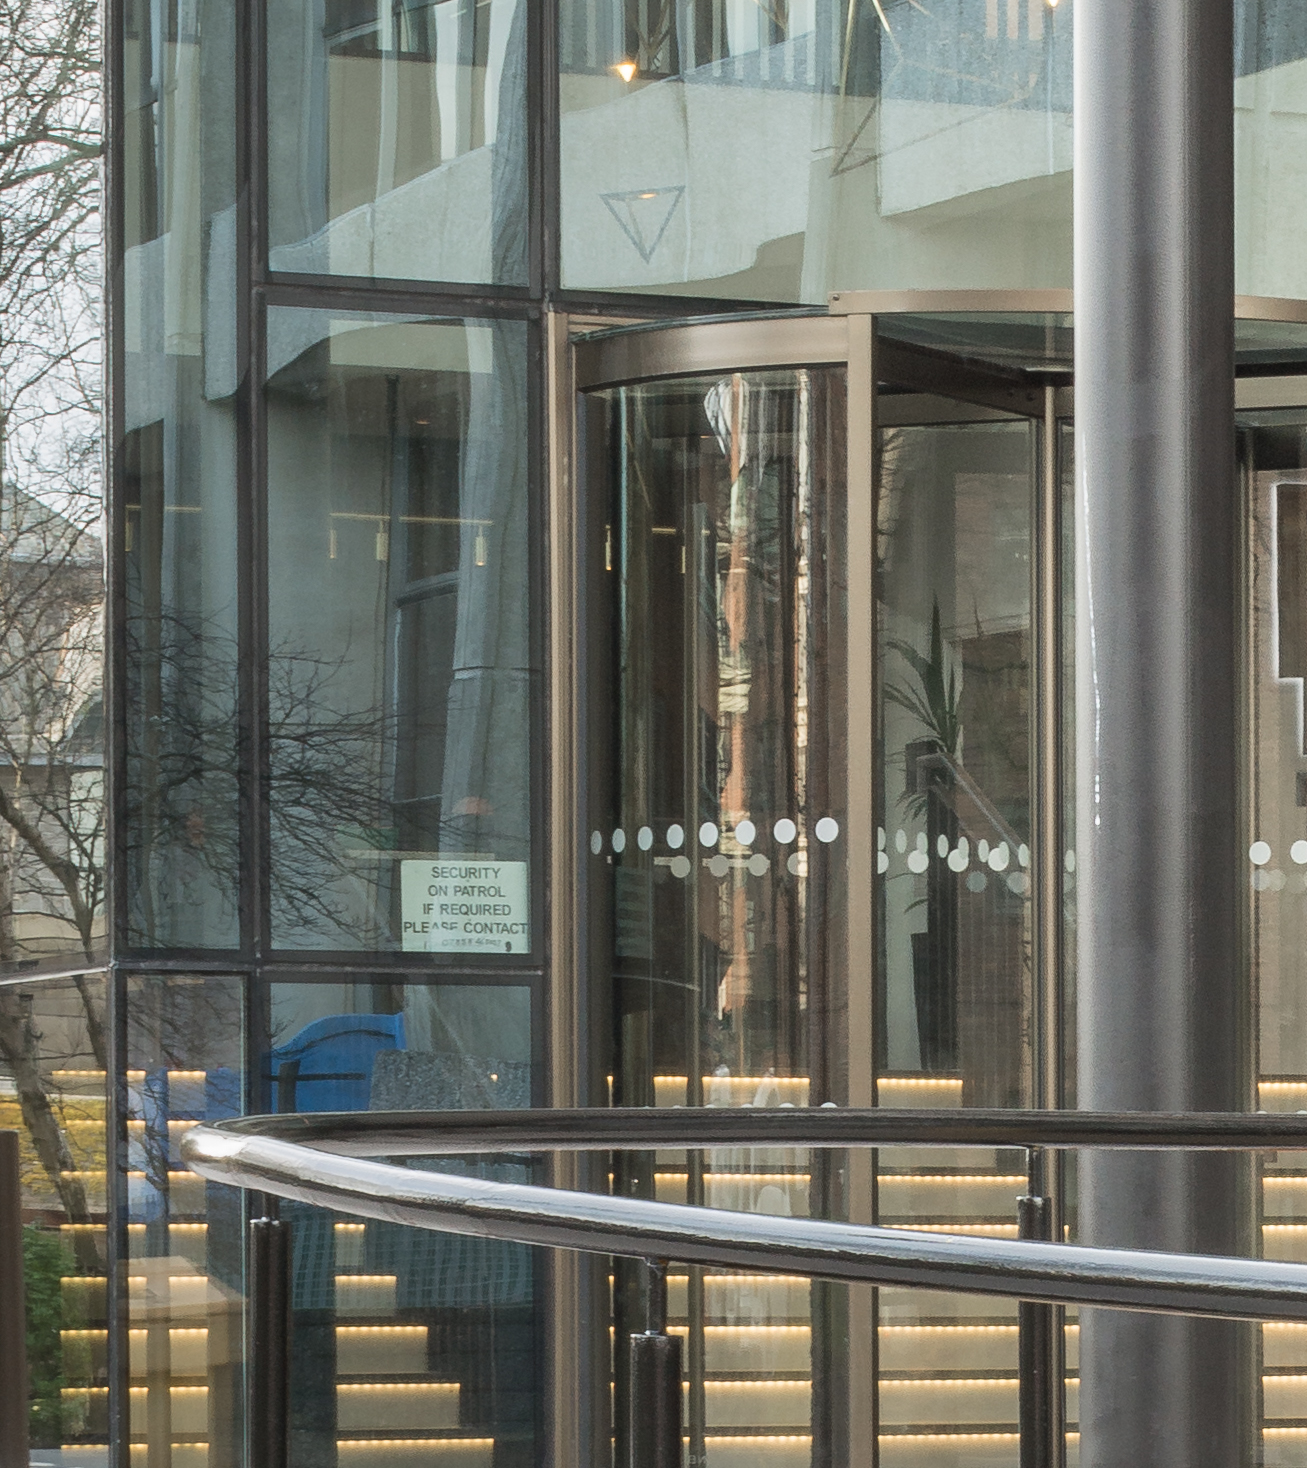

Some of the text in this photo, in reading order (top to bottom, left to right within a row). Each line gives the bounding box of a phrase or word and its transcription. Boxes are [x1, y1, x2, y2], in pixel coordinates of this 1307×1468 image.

[431, 866, 501, 879] SECURITY
[428, 884, 506, 898] ON PATROL
[422, 903, 512, 916] IF REQUIRED
[403, 921, 528, 935] PLEASE CONTACT
